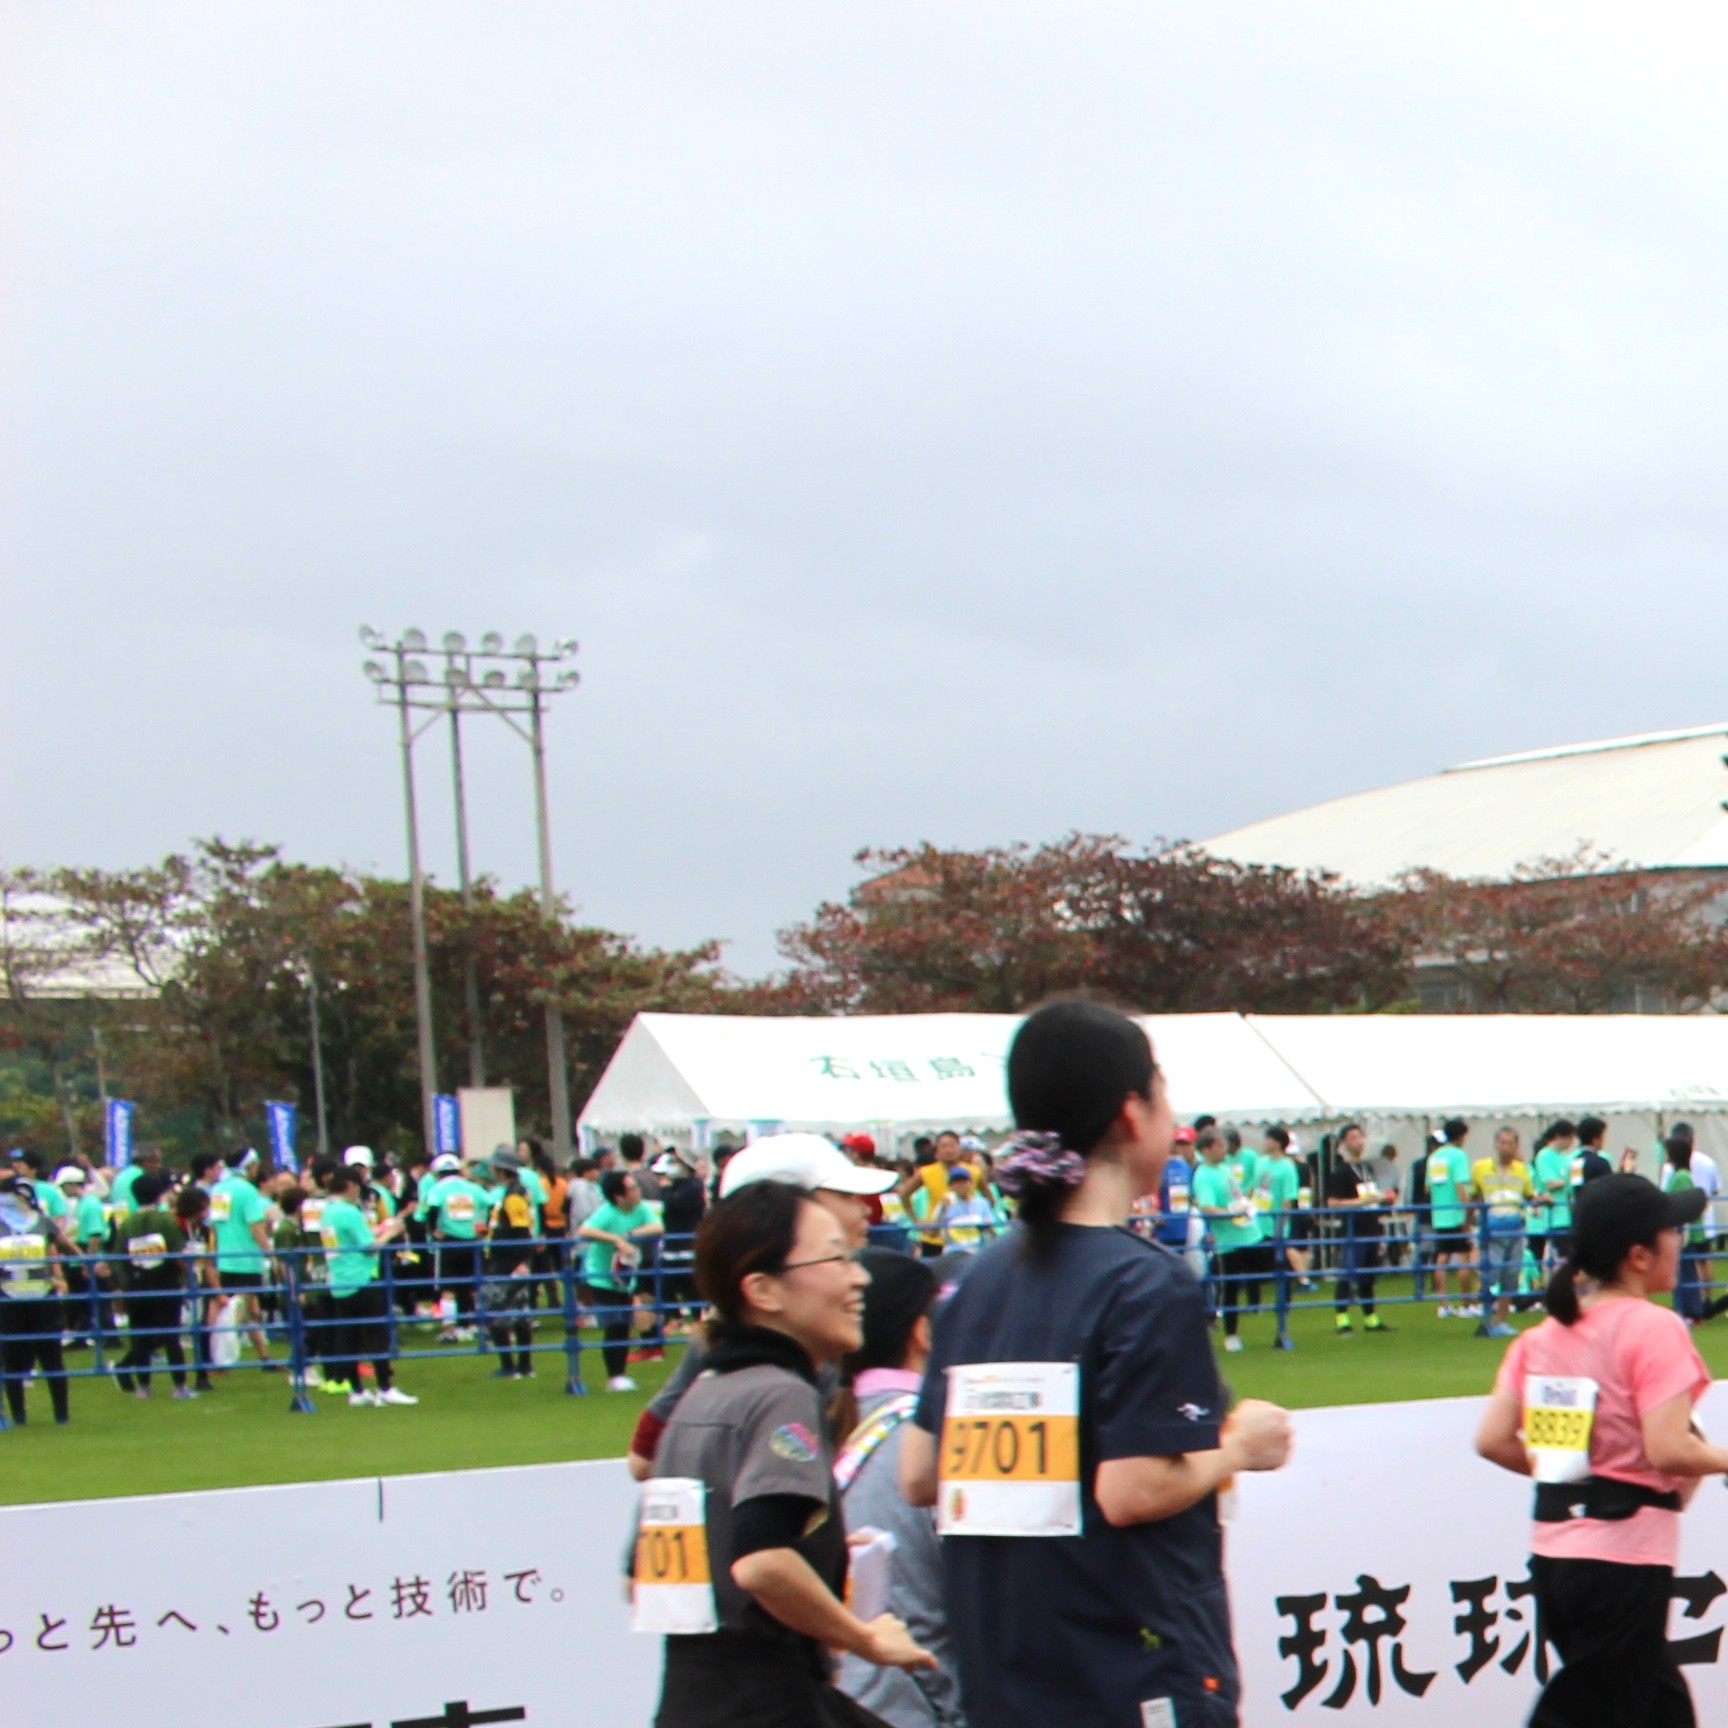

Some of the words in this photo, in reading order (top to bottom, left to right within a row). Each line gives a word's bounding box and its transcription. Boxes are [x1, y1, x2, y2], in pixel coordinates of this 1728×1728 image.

[808, 1053, 1006, 1083] 石垣島
[1531, 1410, 1584, 1446] 8839
